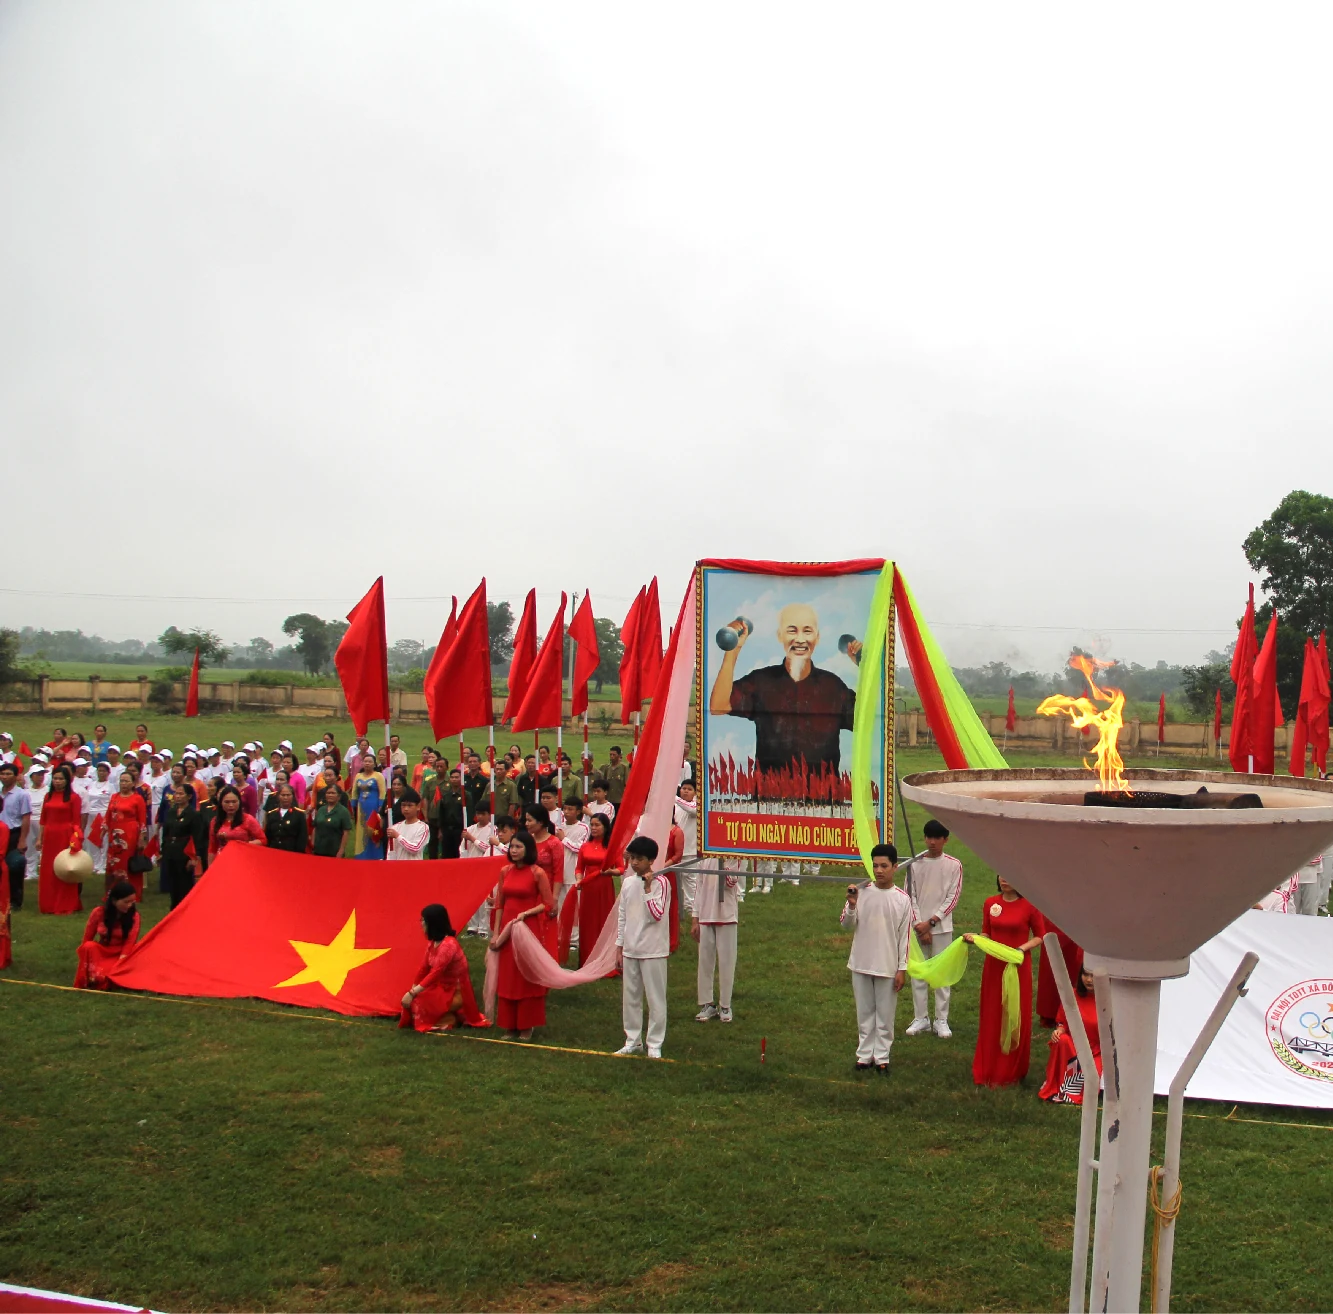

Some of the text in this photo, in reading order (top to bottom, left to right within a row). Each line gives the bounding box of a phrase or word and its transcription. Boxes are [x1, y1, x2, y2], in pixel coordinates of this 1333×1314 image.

[741, 821, 756, 842] TÔI
[759, 820, 786, 844] NGÀY
[789, 821, 811, 845] NÀO
[813, 824, 841, 847] CŨNG
[844, 824, 858, 850] TẬ
[1308, 983, 1320, 992] XÃ
